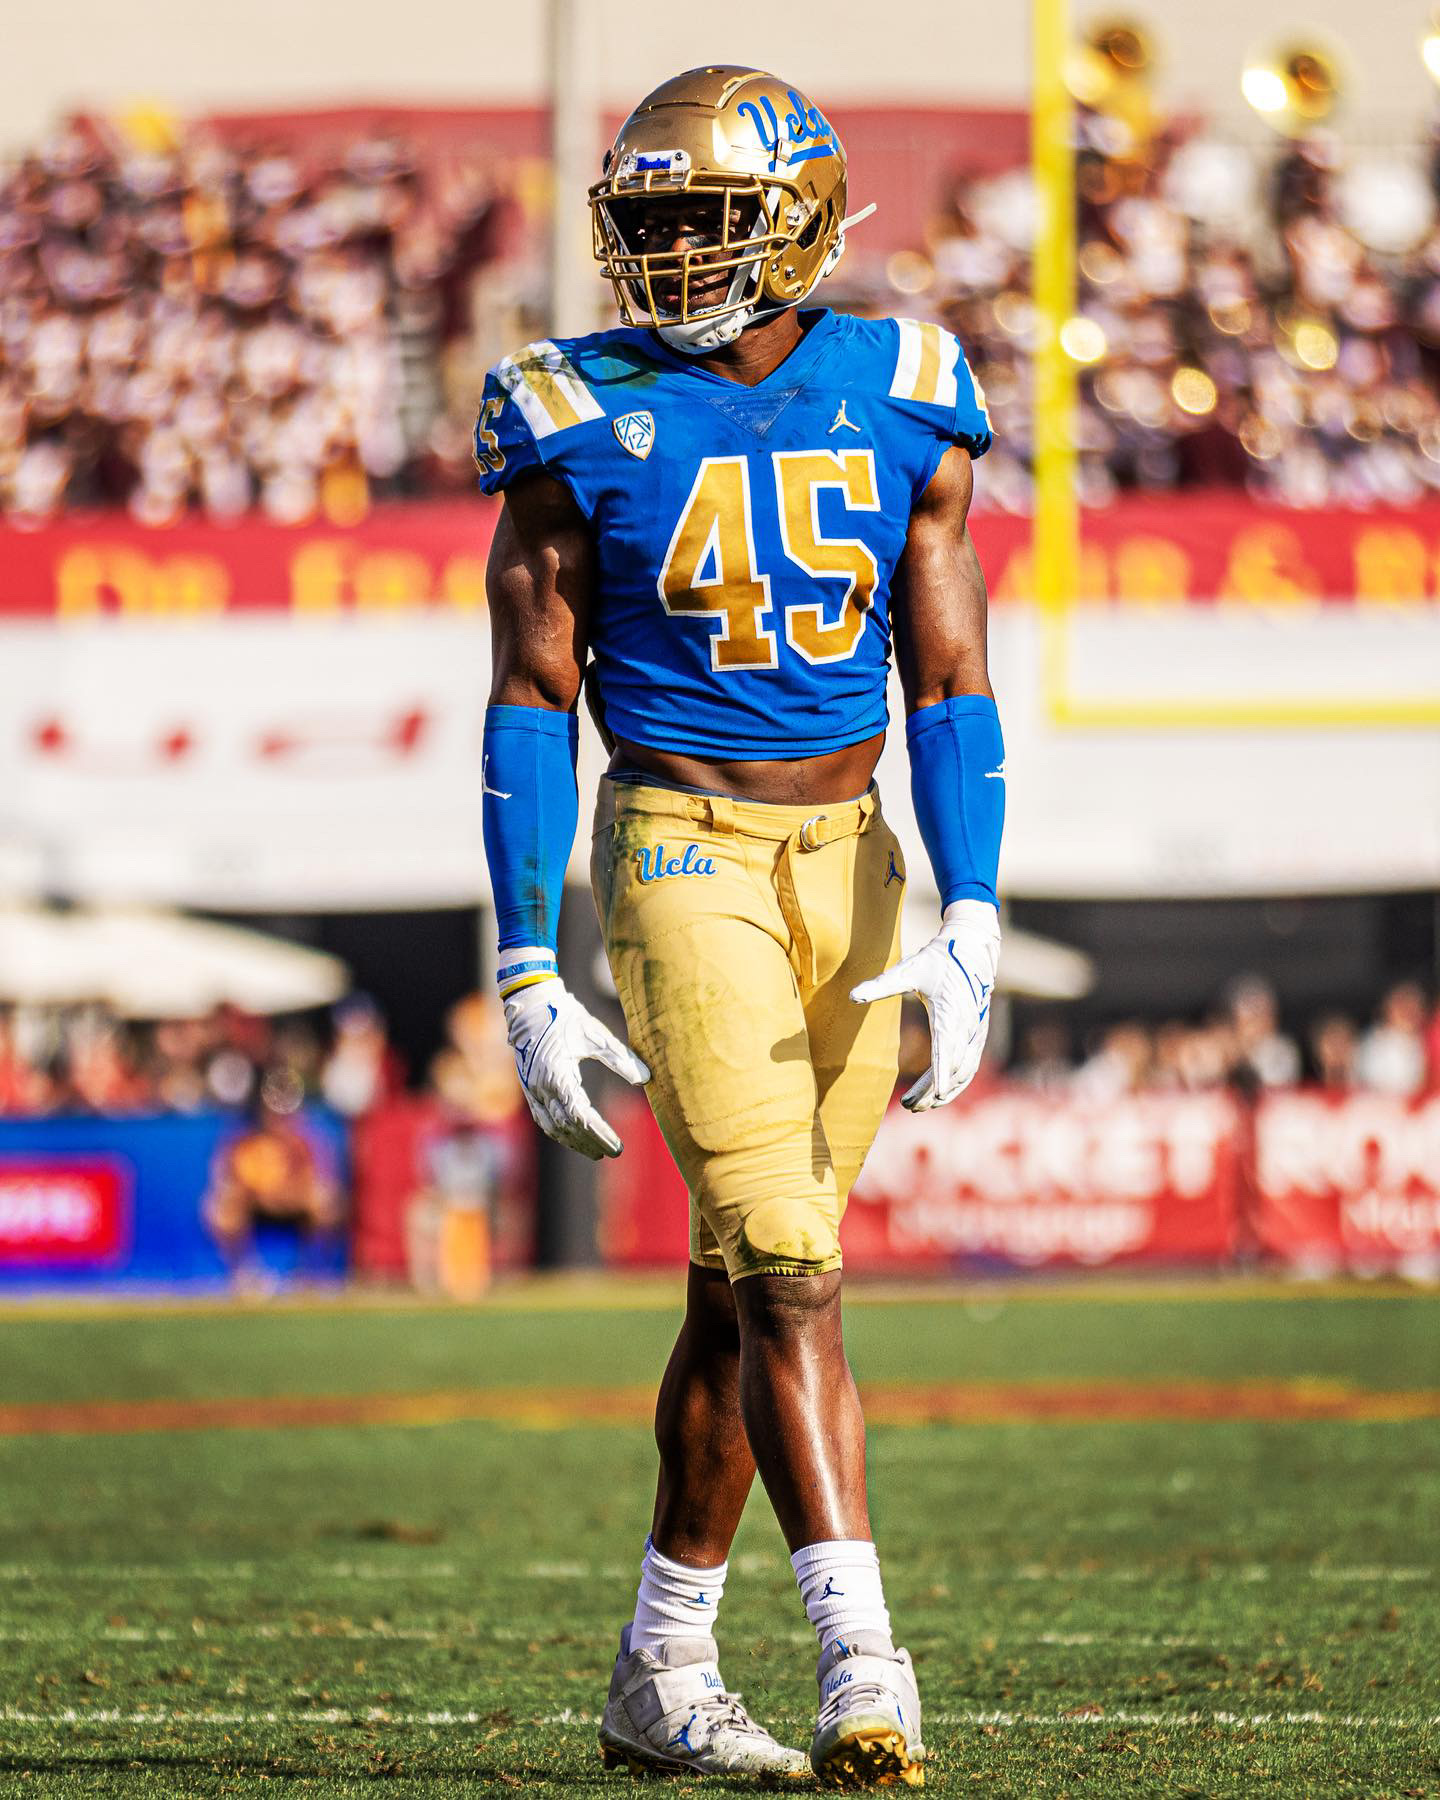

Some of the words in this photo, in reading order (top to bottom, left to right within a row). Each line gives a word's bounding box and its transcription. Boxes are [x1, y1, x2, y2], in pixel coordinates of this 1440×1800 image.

[615, 413, 652, 444] PAC
[628, 431, 649, 450] 12
[657, 449, 881, 672] 45
[635, 843, 718, 882] Ucla
